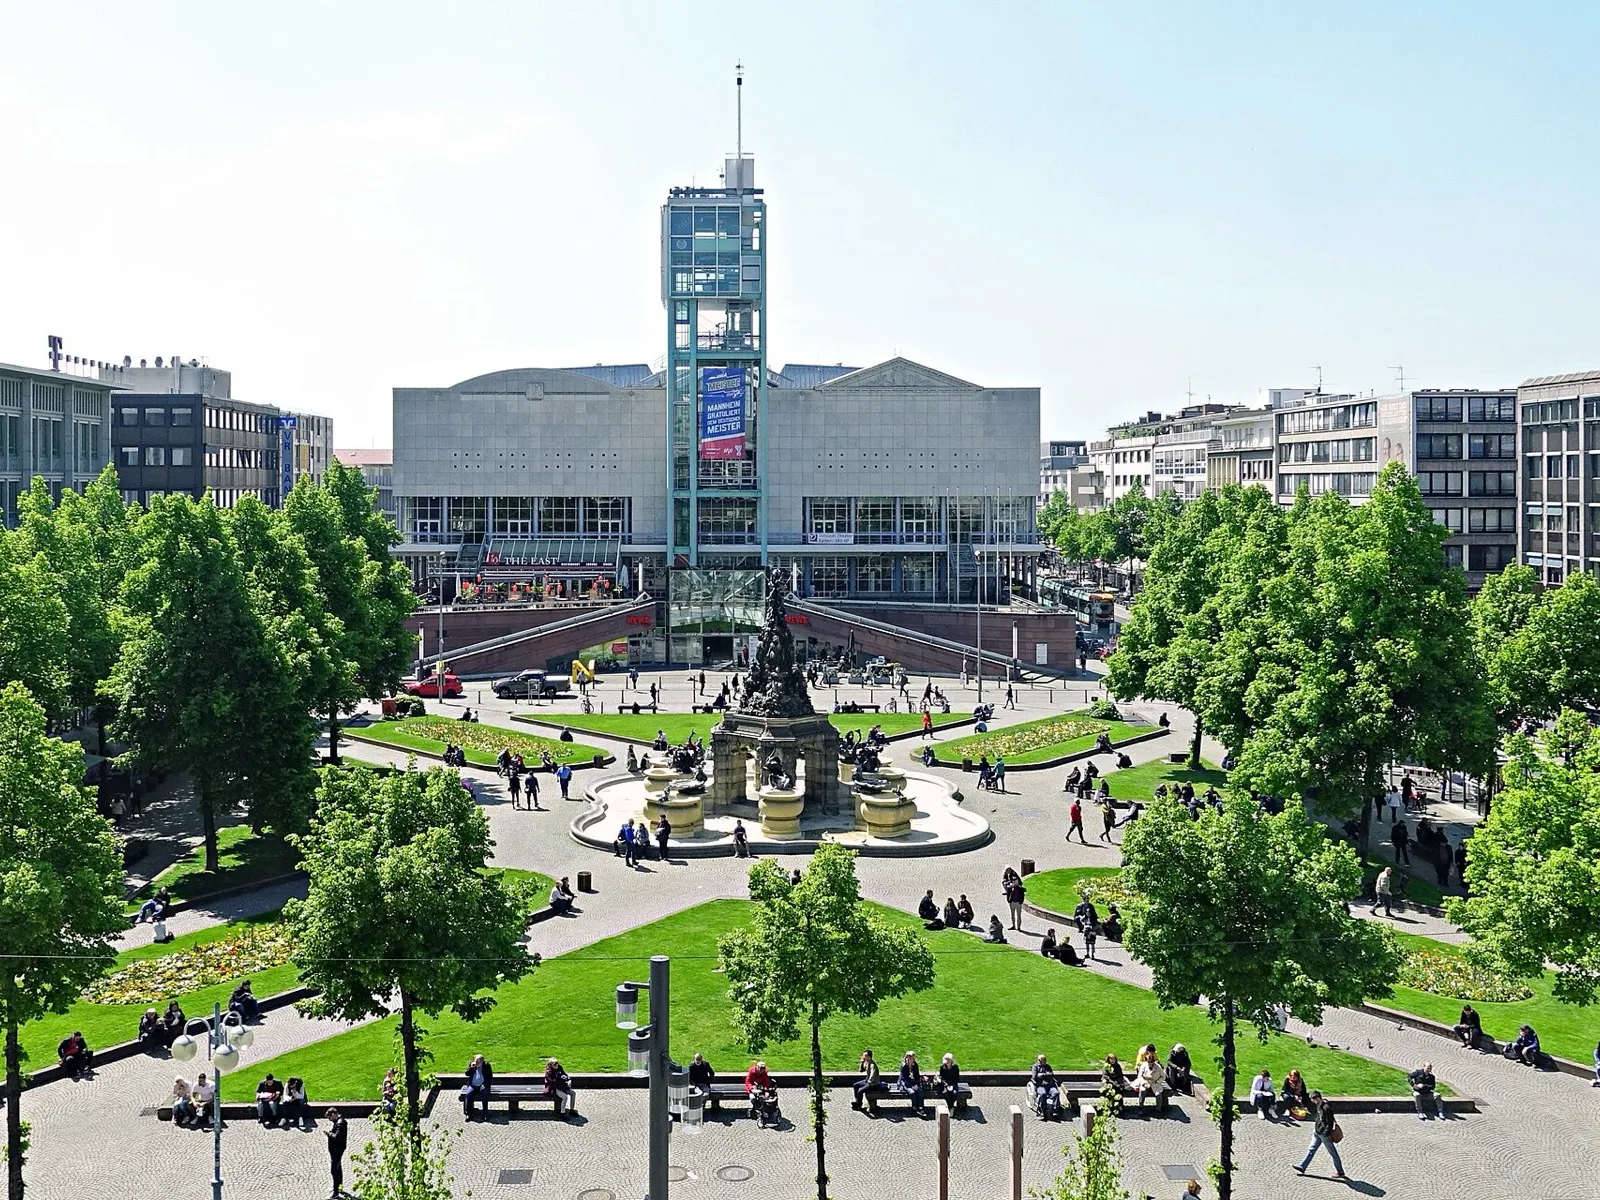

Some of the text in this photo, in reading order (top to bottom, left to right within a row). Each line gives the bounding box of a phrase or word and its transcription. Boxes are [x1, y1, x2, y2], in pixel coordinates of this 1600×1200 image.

[707, 400, 741, 412] MANNHEIM
[707, 408, 741, 420] GRATULIERT
[707, 421, 741, 434] MEISTER
[284, 431, 291, 451] VR
[504, 557, 528, 565] THE
[531, 557, 558, 565] EAST
[627, 616, 650, 625] REWE
